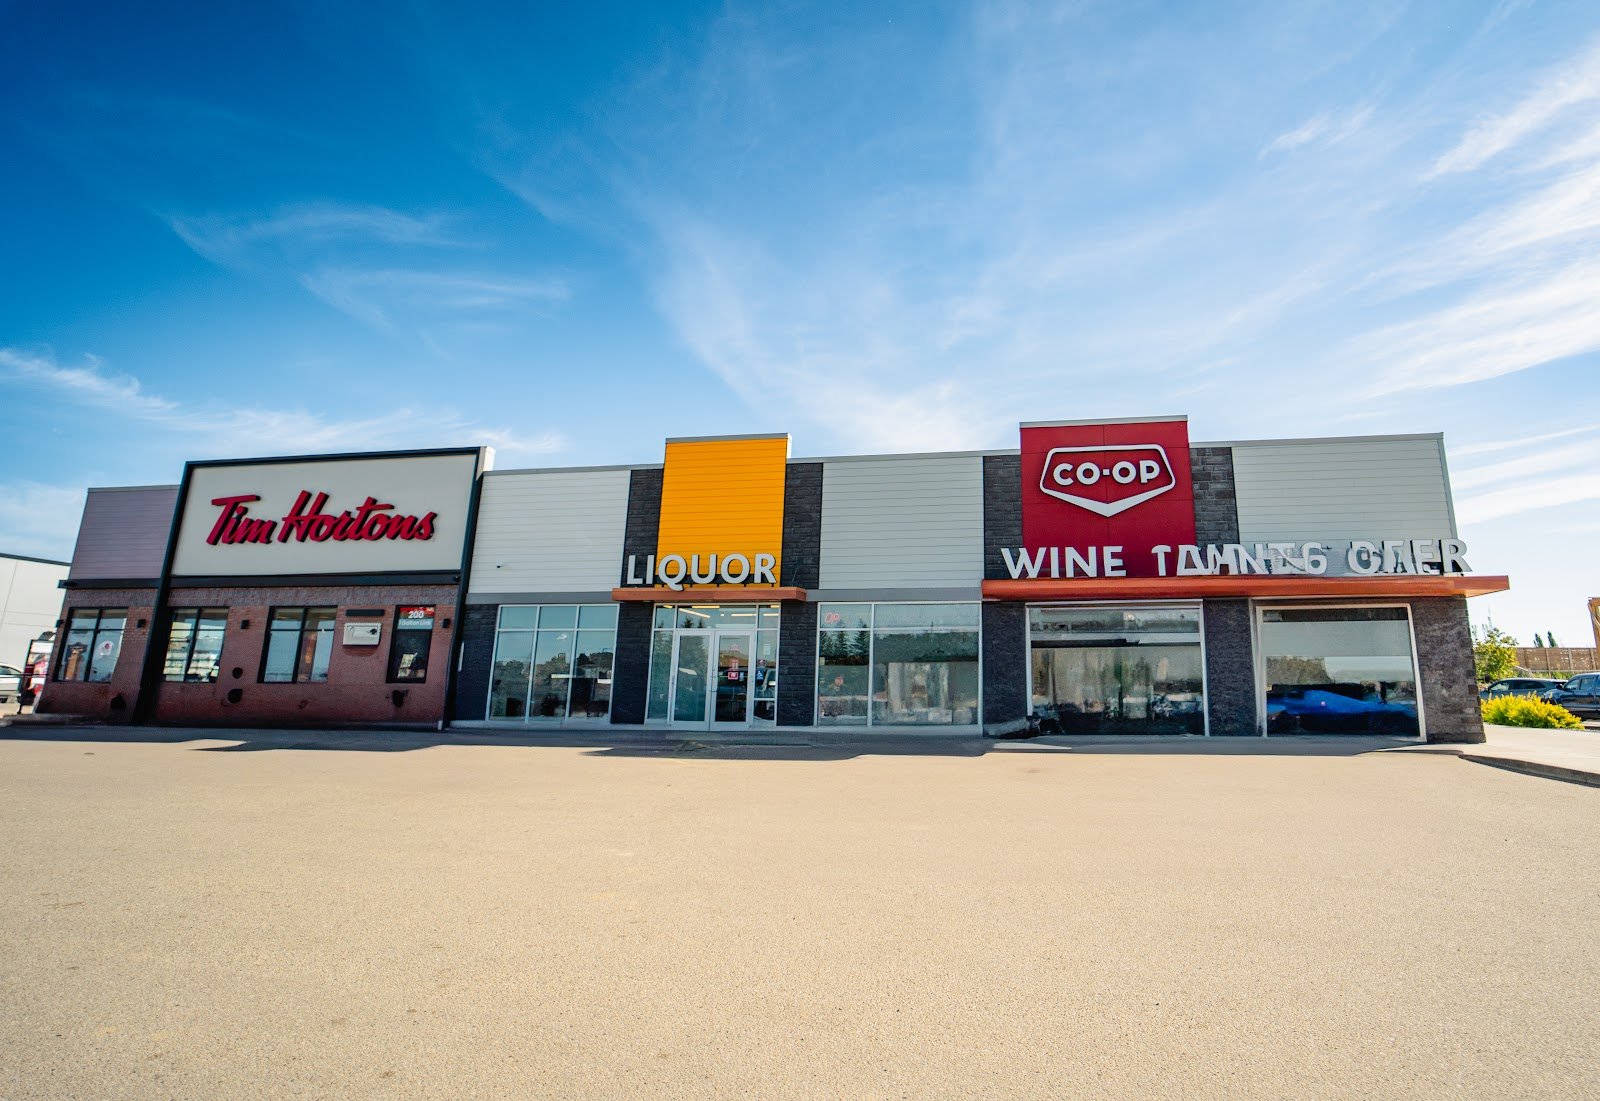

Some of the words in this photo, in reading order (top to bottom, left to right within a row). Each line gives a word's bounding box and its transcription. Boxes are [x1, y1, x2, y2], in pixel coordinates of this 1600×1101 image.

[1053, 460, 1160, 486] CO-OP
[206, 495, 277, 546] Tim
[277, 490, 437, 543] Hortons
[626, 553, 777, 591] LIQUOR
[1000, 546, 1127, 579] WINE
[408, 610, 424, 618] 200
